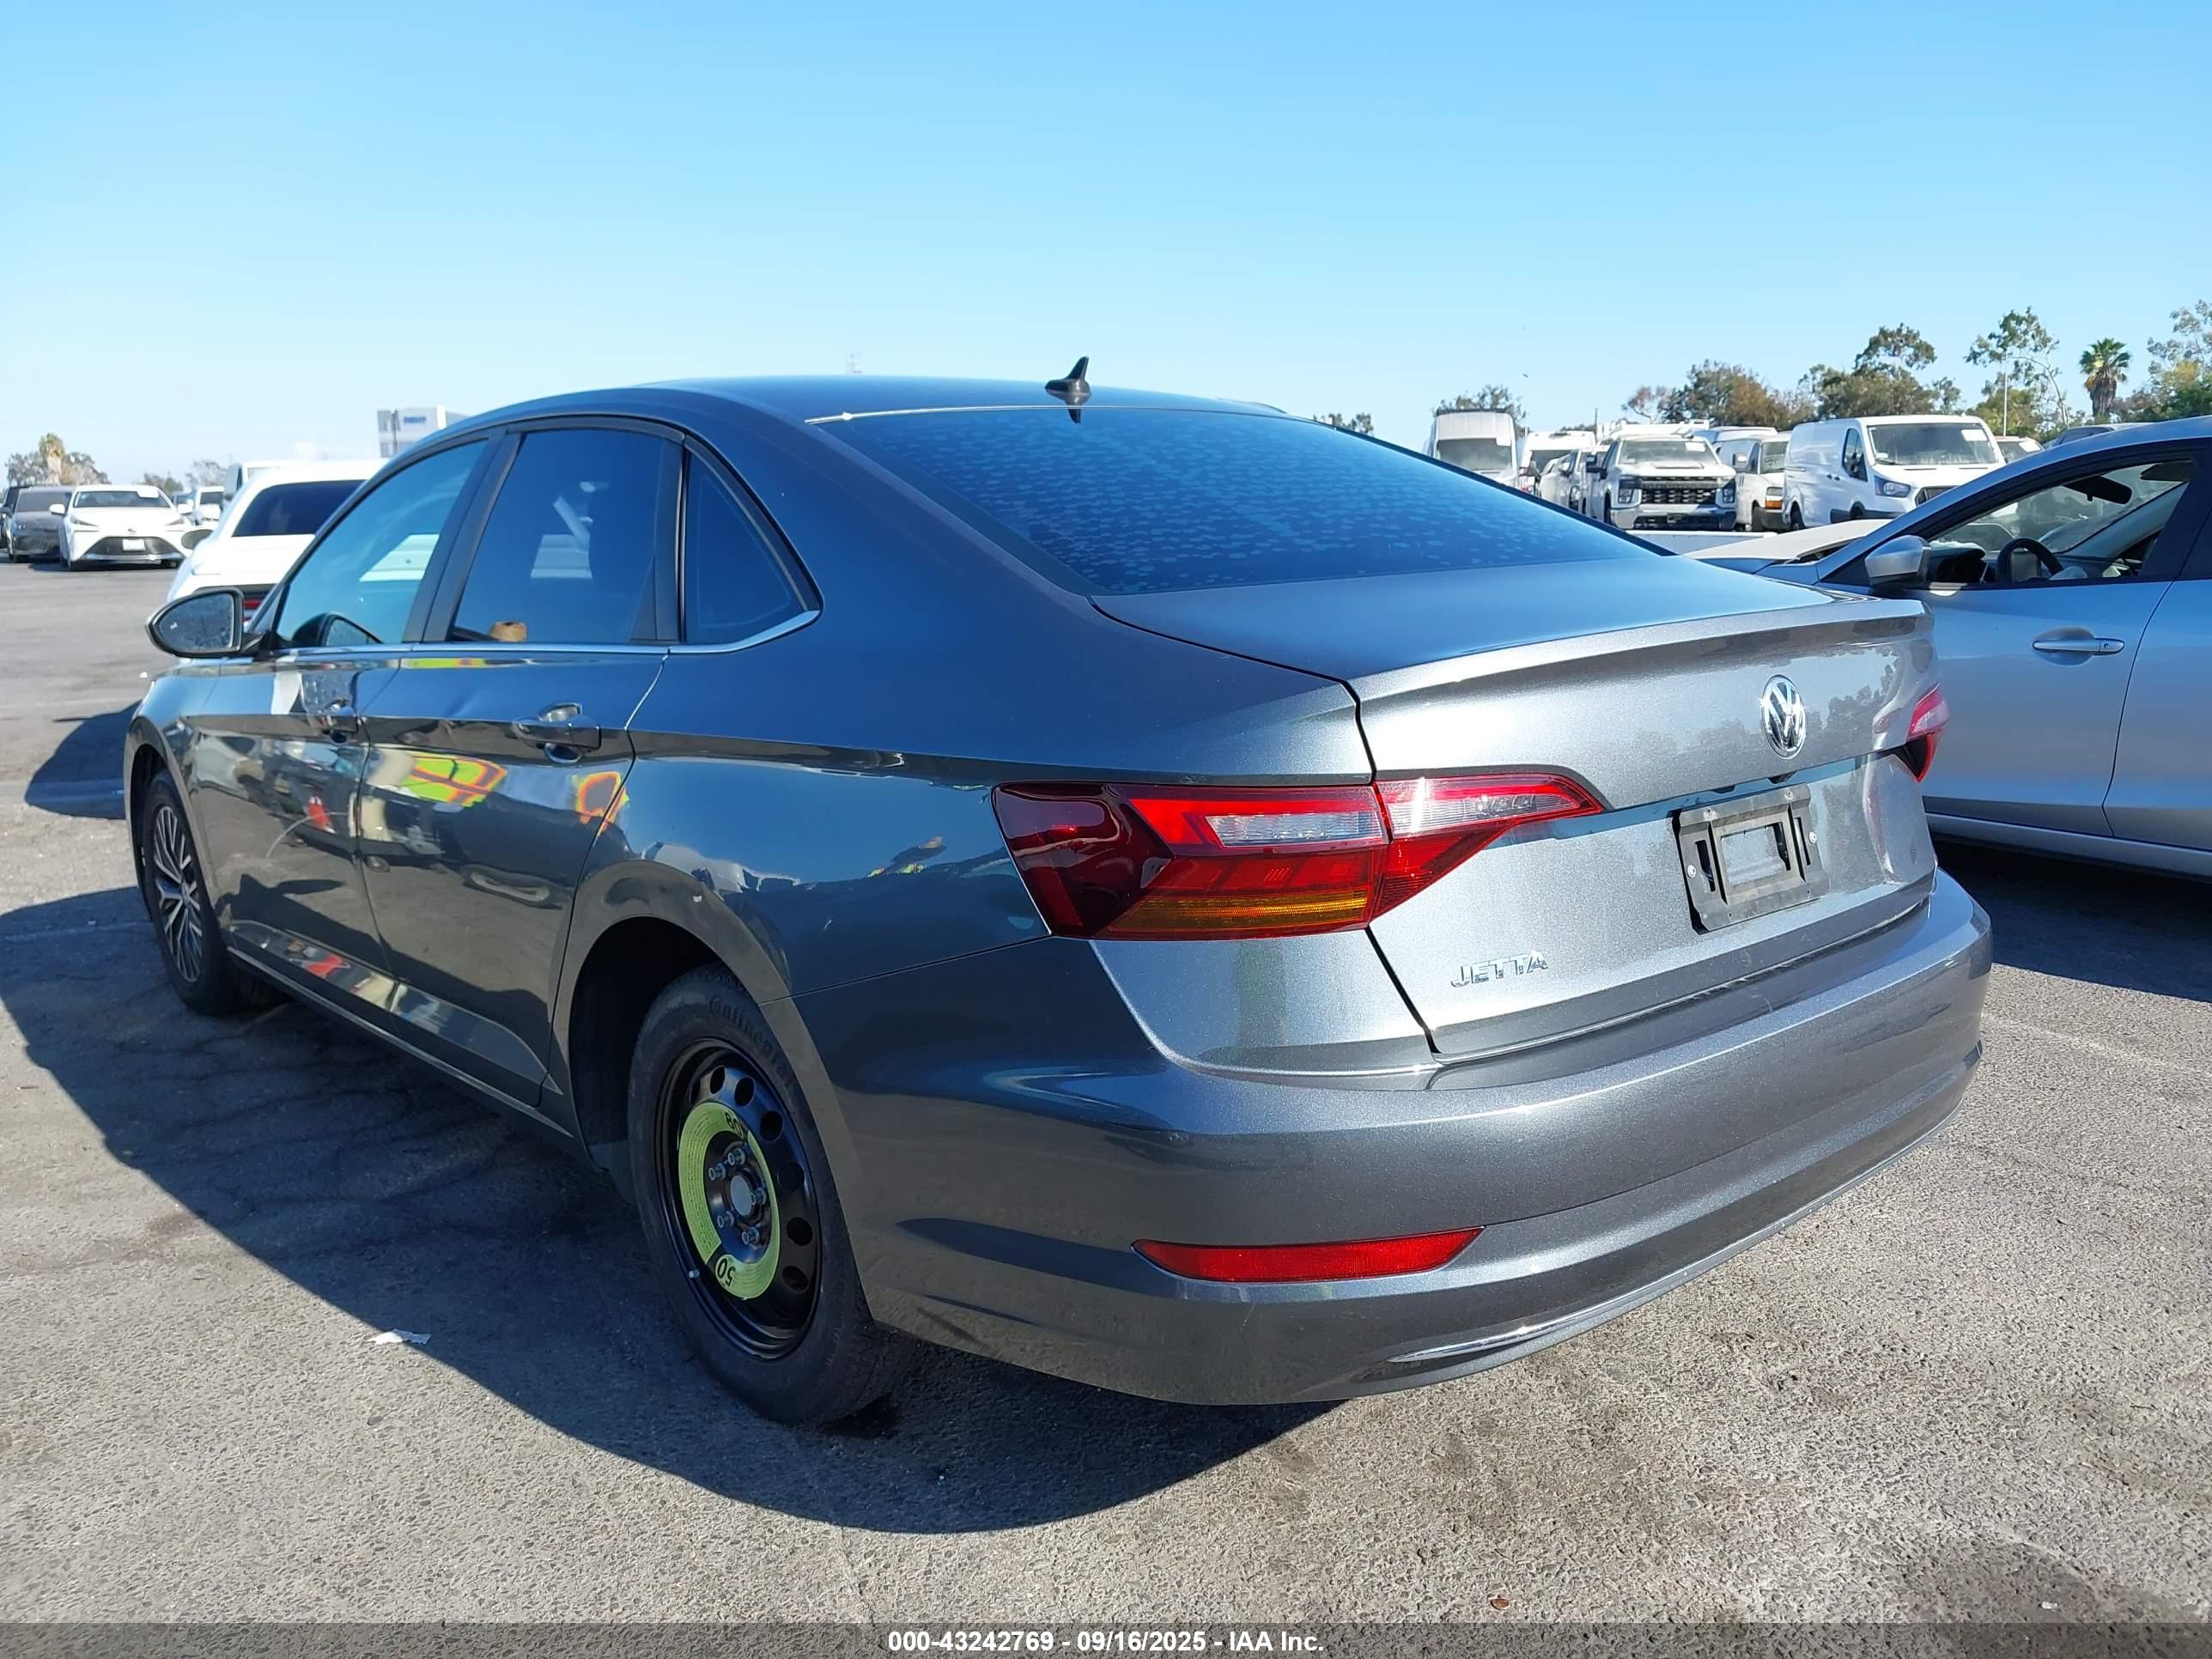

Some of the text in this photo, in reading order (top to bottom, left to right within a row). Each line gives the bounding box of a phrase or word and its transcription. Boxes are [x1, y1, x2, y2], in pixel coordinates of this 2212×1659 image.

[1450, 949, 1548, 988] JETTA
[724, 1109, 744, 1138] 80
[717, 1257, 737, 1287] 50
